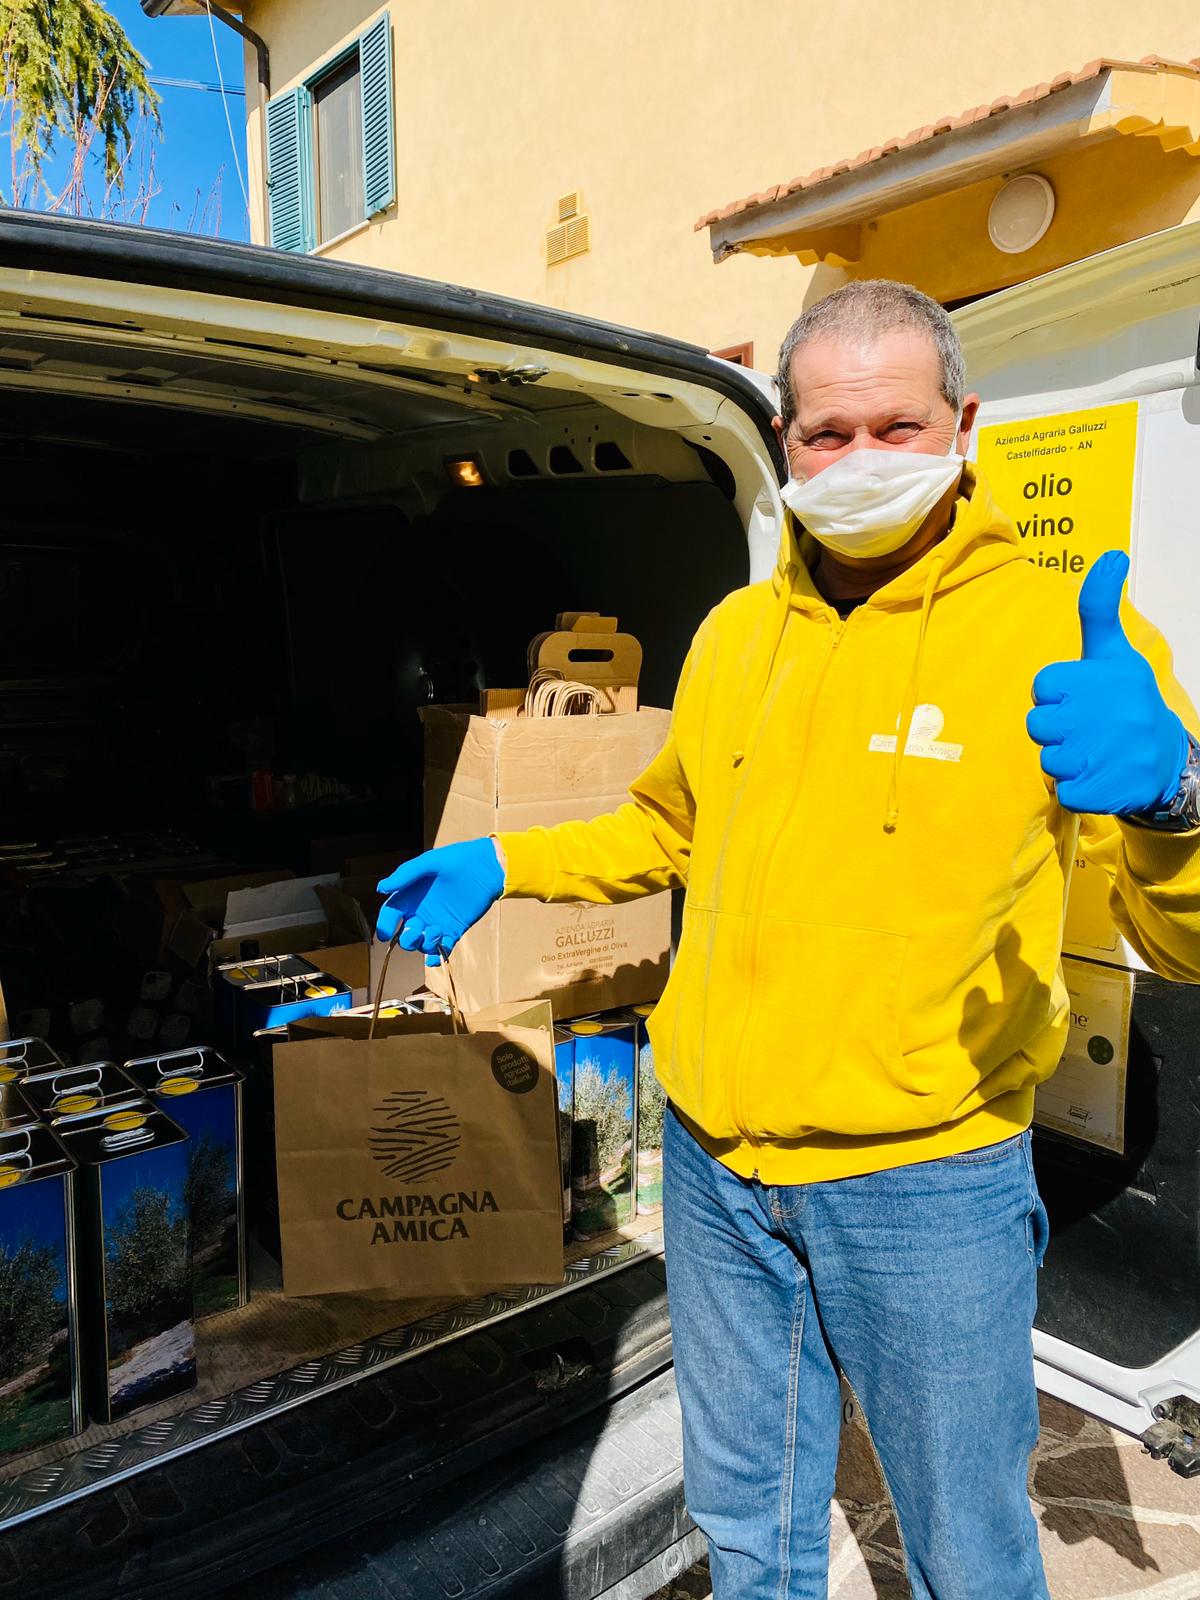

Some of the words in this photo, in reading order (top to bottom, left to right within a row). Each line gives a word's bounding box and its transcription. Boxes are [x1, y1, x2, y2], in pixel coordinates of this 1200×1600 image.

[995, 432, 1030, 446] Azienda
[1032, 427, 1066, 442] Agraria
[1068, 420, 1107, 435] Galluzzi
[1006, 444, 1067, 461] Castelfidardo
[1078, 440, 1093, 451] AN
[1023, 473, 1073, 500] olio
[1016, 514, 1074, 538] vino
[1027, 549, 1085, 573] iele
[555, 927, 615, 948] GALLUZZI
[336, 1190, 500, 1221] CAMPAGNA
[371, 1217, 470, 1245] AMICA
